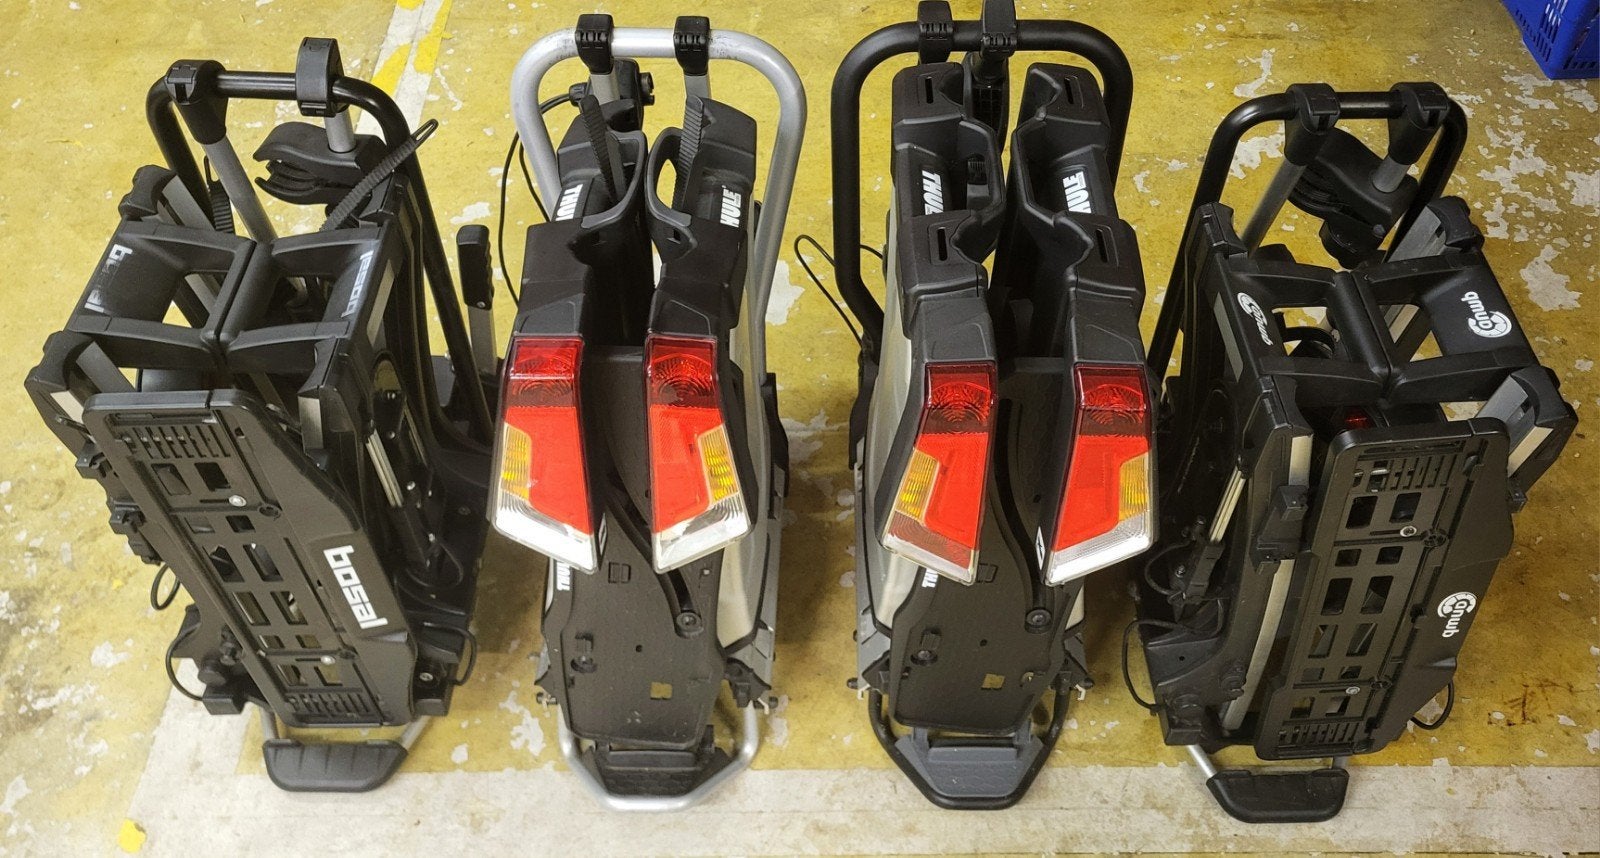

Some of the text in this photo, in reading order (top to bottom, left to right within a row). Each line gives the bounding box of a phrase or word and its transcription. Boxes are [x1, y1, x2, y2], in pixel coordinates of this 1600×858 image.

[720, 188, 742, 227] HULE
[1063, 171, 1092, 214] HULE
[341, 250, 374, 318] bosal
[323, 545, 388, 629] bosal
